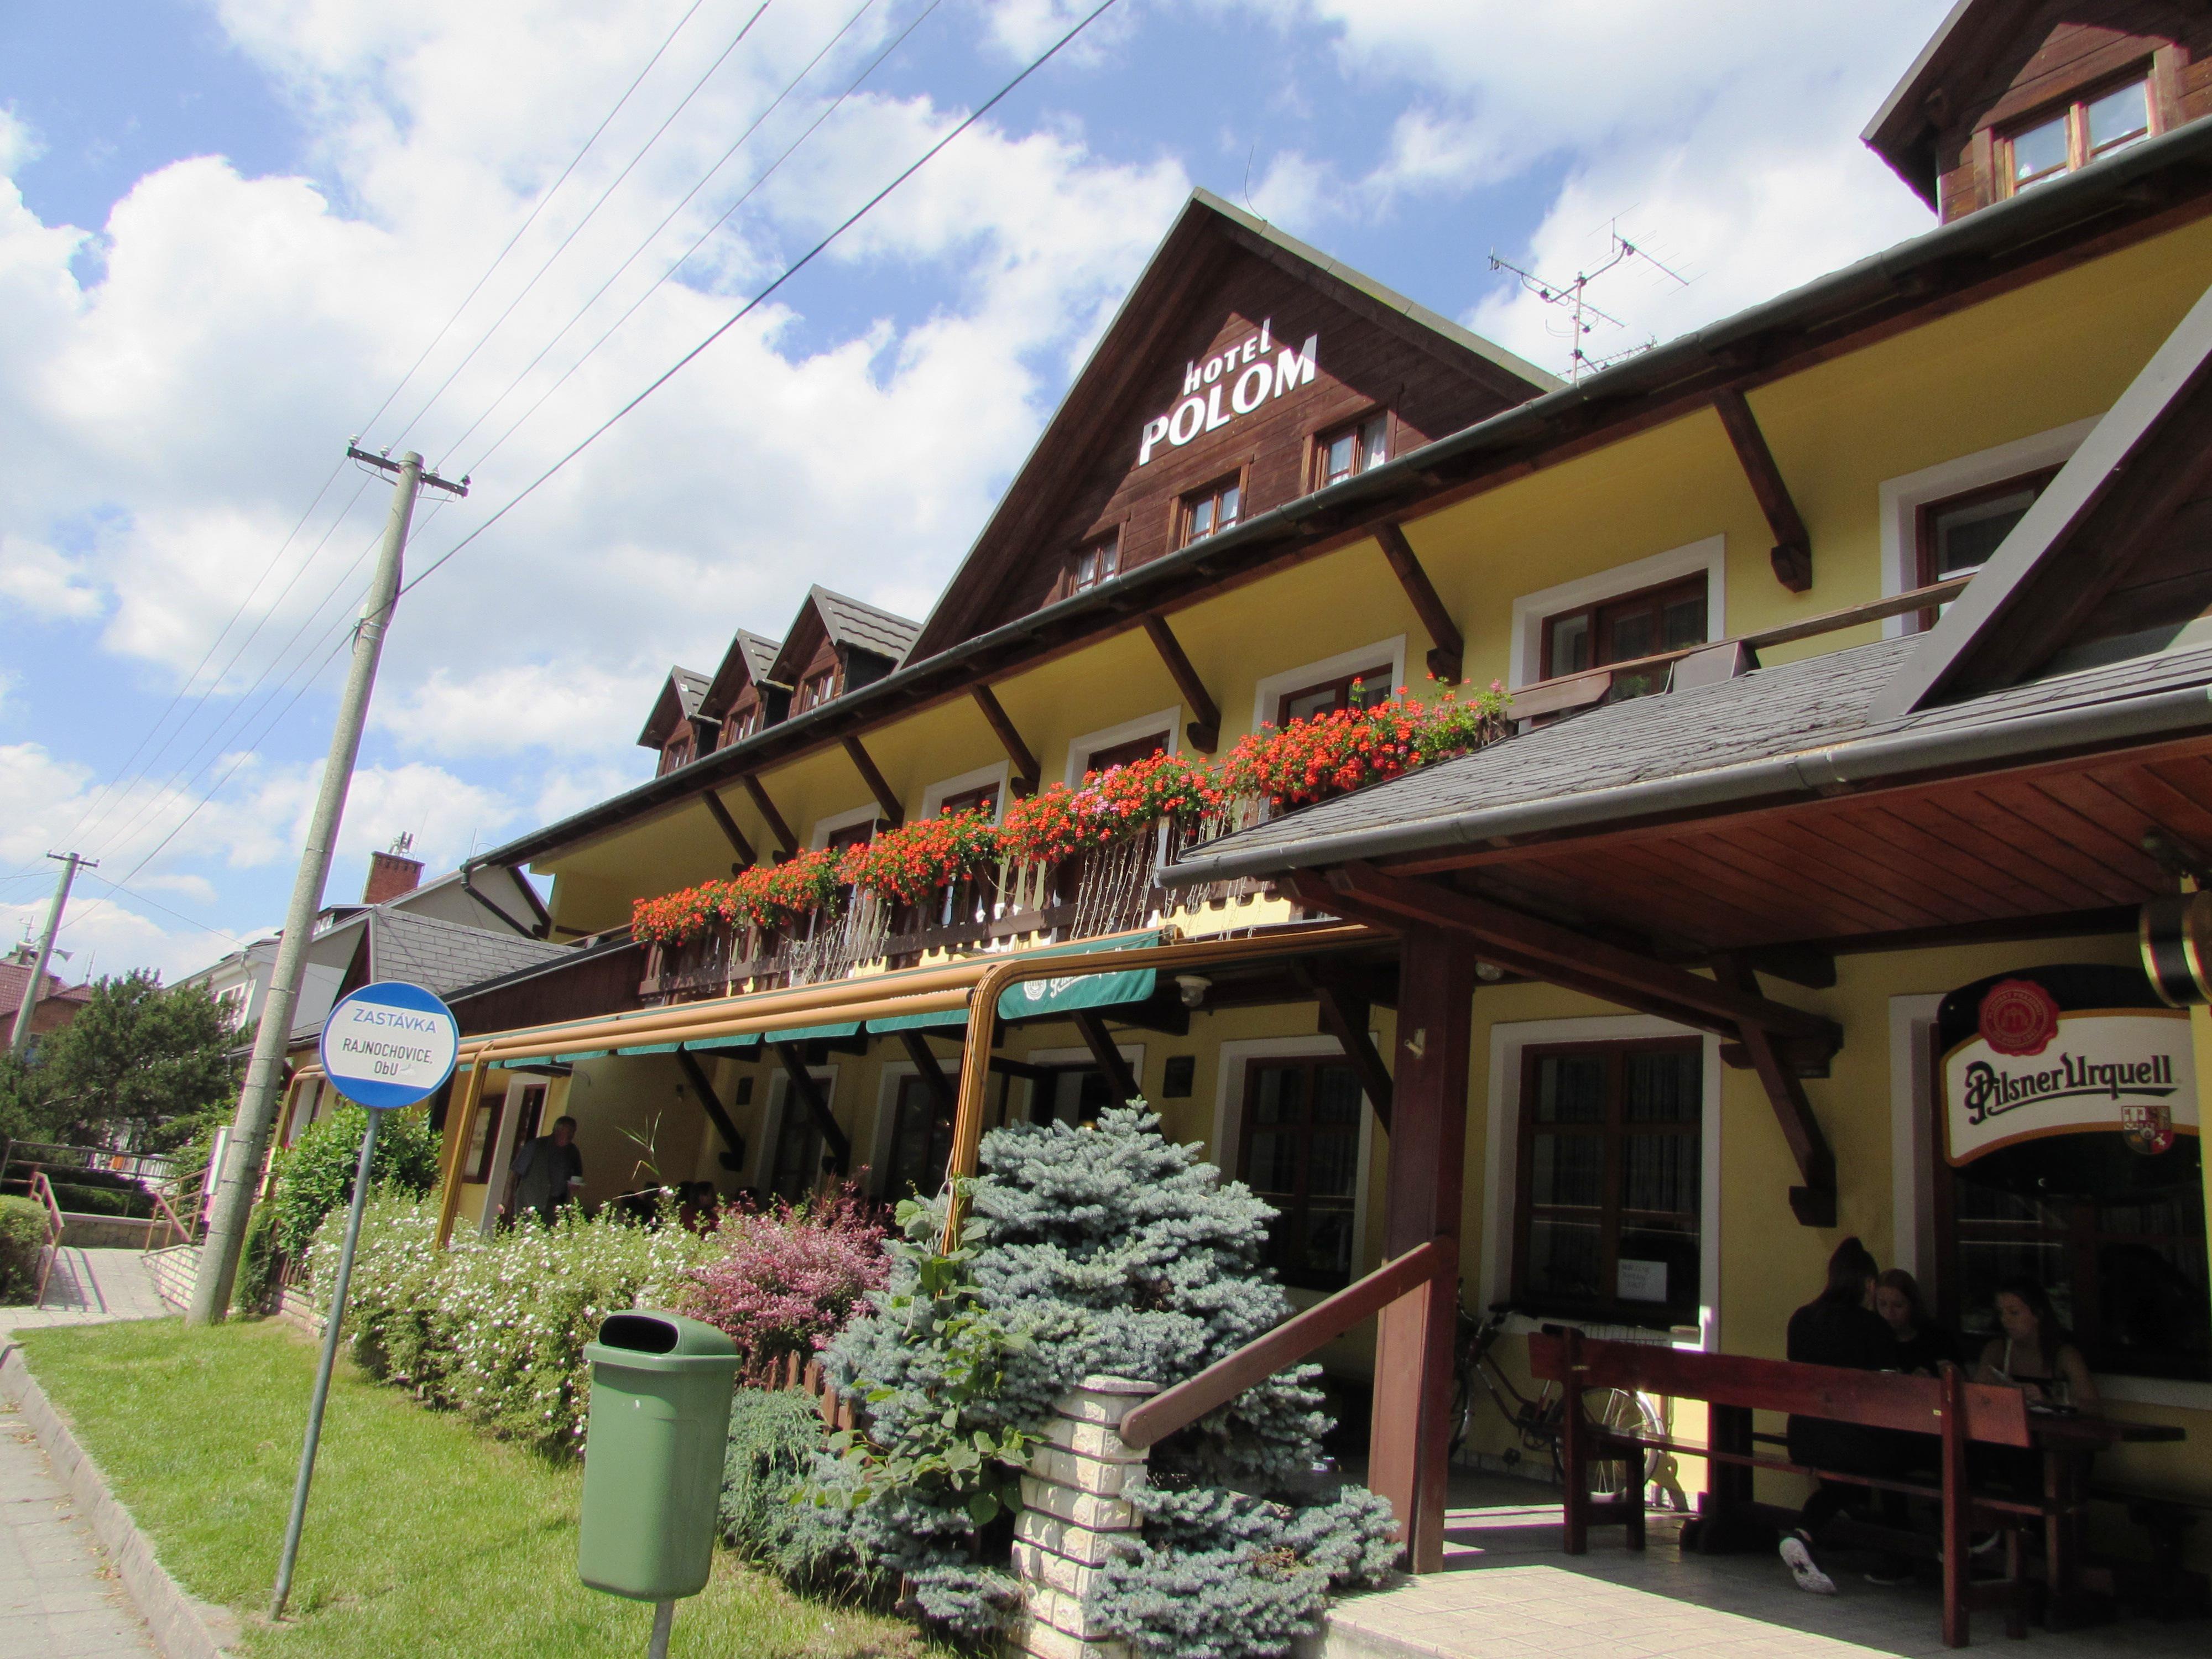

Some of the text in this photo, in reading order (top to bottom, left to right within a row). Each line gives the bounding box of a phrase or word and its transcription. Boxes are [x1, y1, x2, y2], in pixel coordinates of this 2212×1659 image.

[1183, 318, 1271, 397] HOTEL
[1139, 334, 1318, 466] POLOM
[342, 1038, 432, 1064] RAJNOCHOVICE,
[353, 1009, 436, 1034] ZASTÁVKA
[1964, 1052, 2173, 1125] Pilsner Urquell
